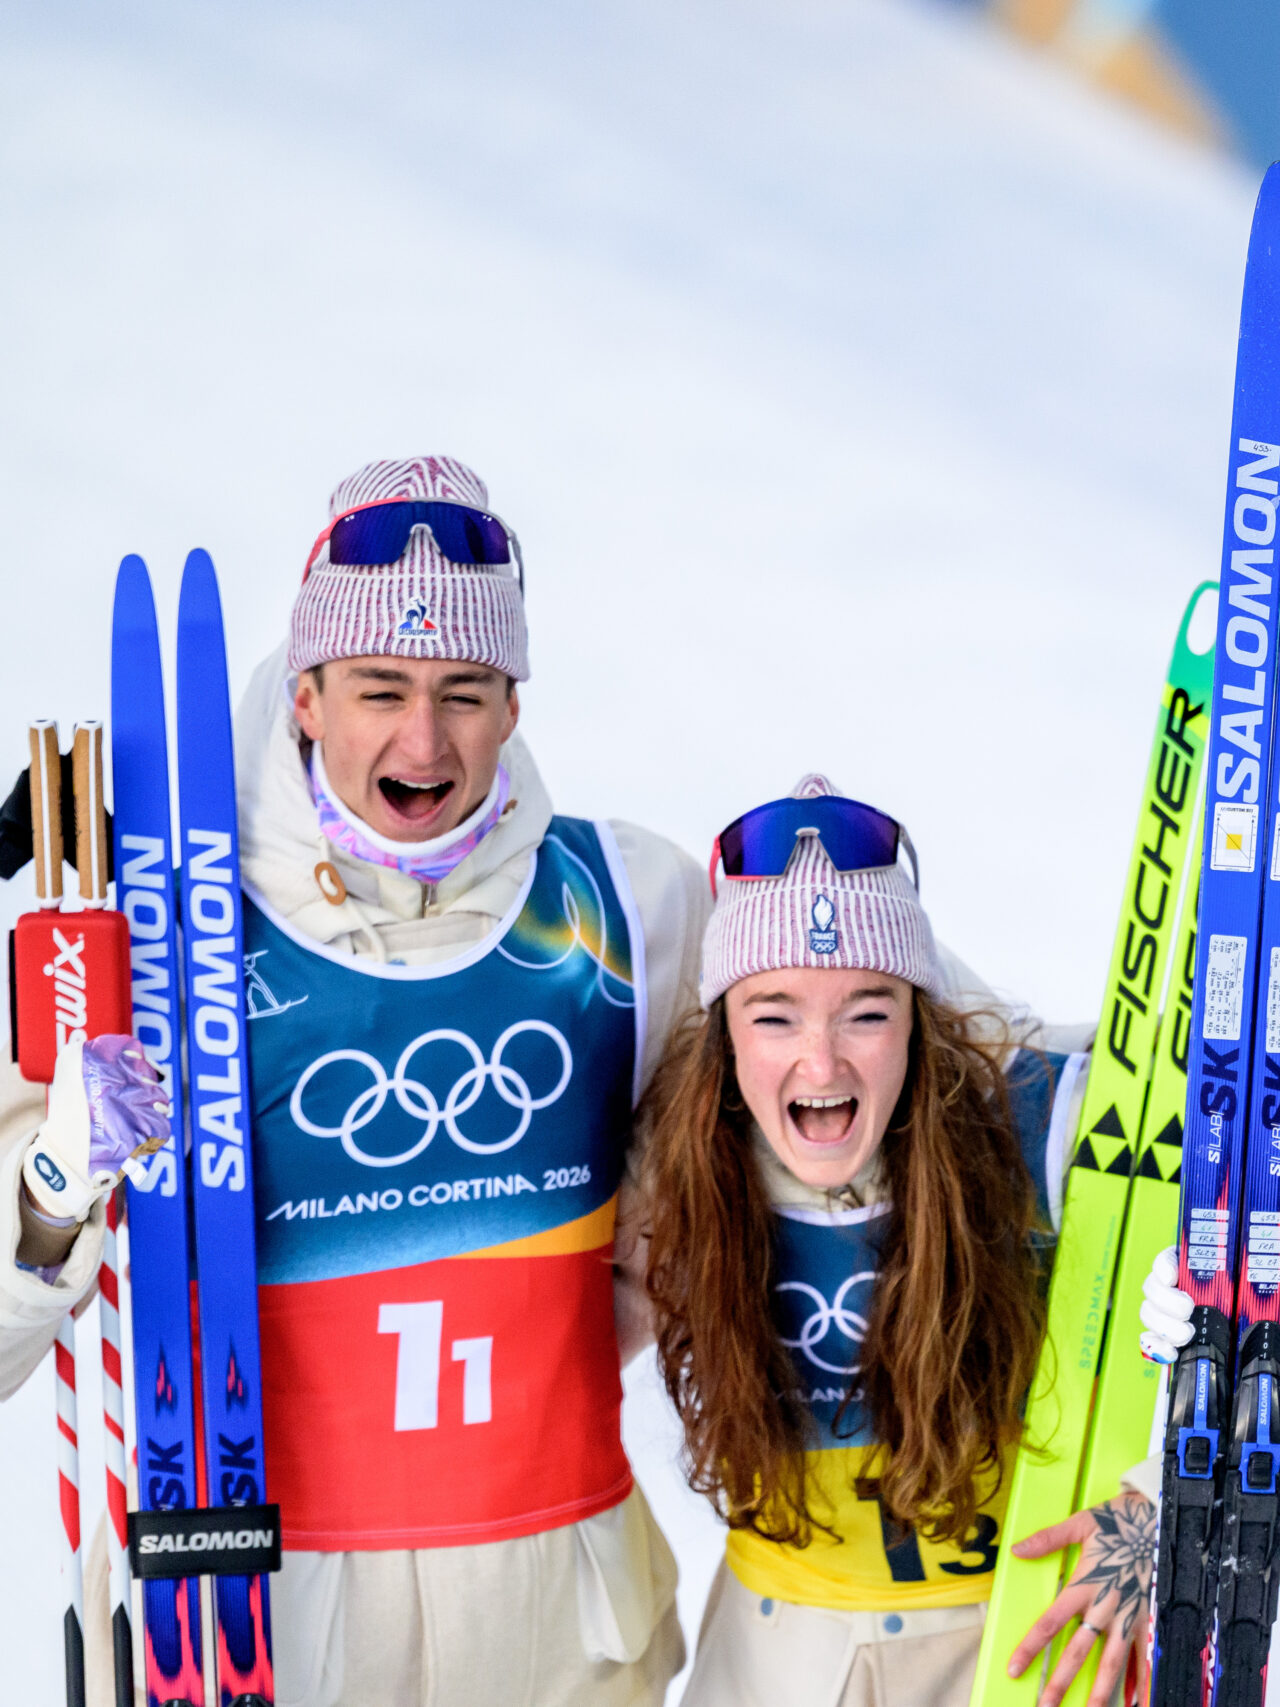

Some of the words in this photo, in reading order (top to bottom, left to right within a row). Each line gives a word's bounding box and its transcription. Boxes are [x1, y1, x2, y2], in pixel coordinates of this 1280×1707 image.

[1216, 437, 1280, 804] SALOMON
[1109, 687, 1205, 1077] FISCHER
[121, 834, 178, 1198] SOMON
[187, 829, 246, 1192] SALOMON
[1200, 1041, 1240, 1122] SK
[265, 1188, 403, 1221] MILANO
[407, 1173, 539, 1207] CORTINA
[542, 1164, 592, 1192] 2026
[1197, 1363, 1208, 1411] SALOMON
[1260, 1378, 1270, 1425] SALOMON
[138, 1530, 273, 1554] SALOMON
